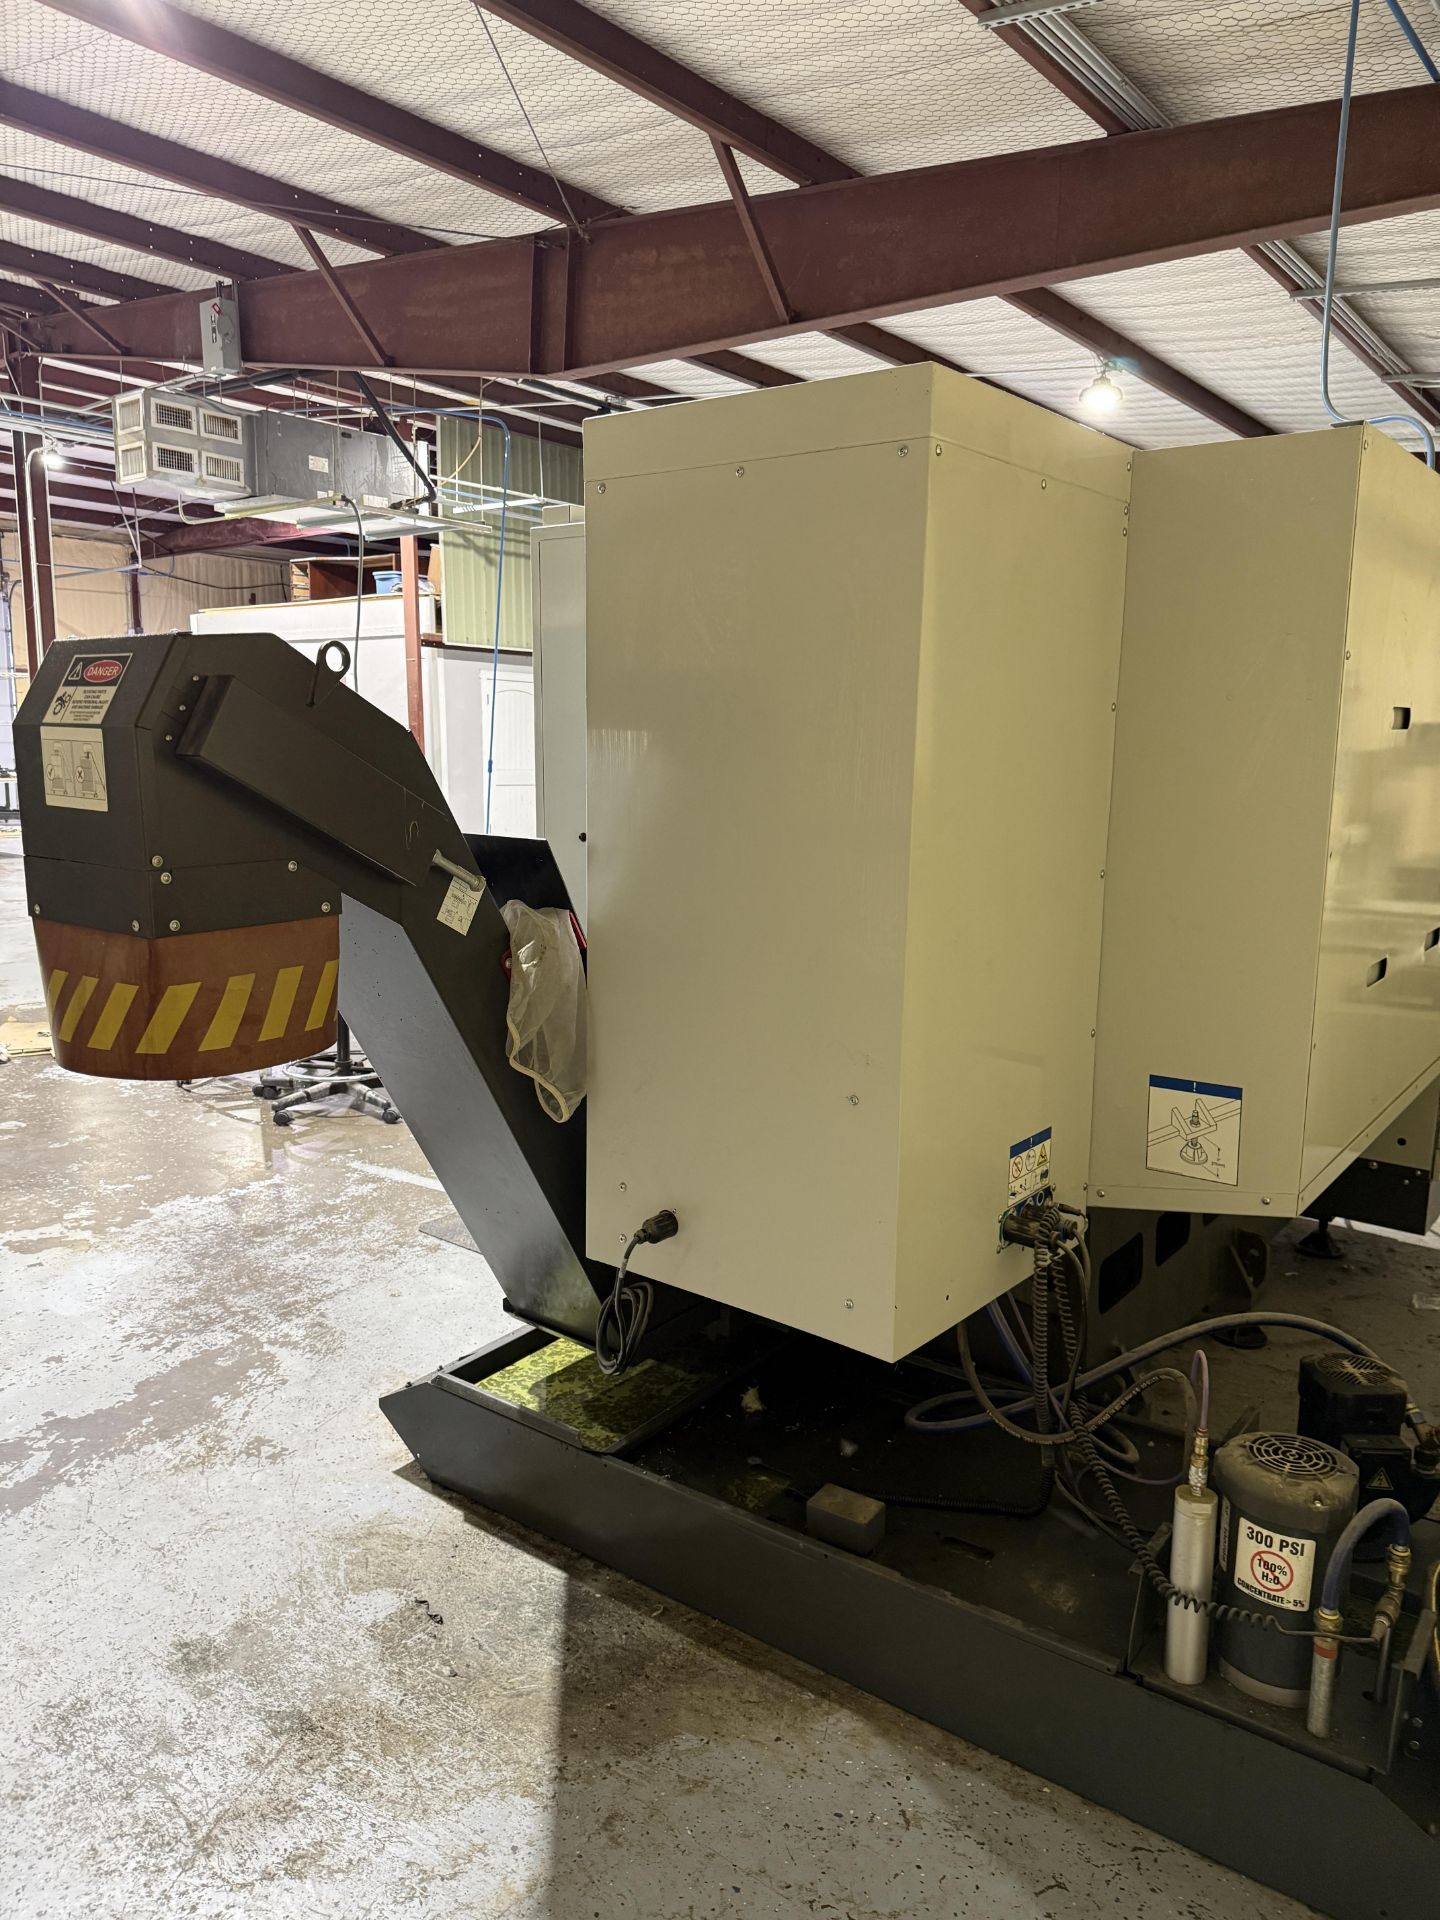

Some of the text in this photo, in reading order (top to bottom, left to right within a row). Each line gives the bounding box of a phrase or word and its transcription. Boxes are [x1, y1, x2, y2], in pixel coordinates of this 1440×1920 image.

[87, 667, 119, 676] DANGER
[1246, 1526, 1305, 1557] 300 PSI
[1257, 1558, 1287, 1577] 100%
[1237, 1577, 1285, 1605] CONCENTRATE
[1292, 1599, 1305, 1608] 5%
